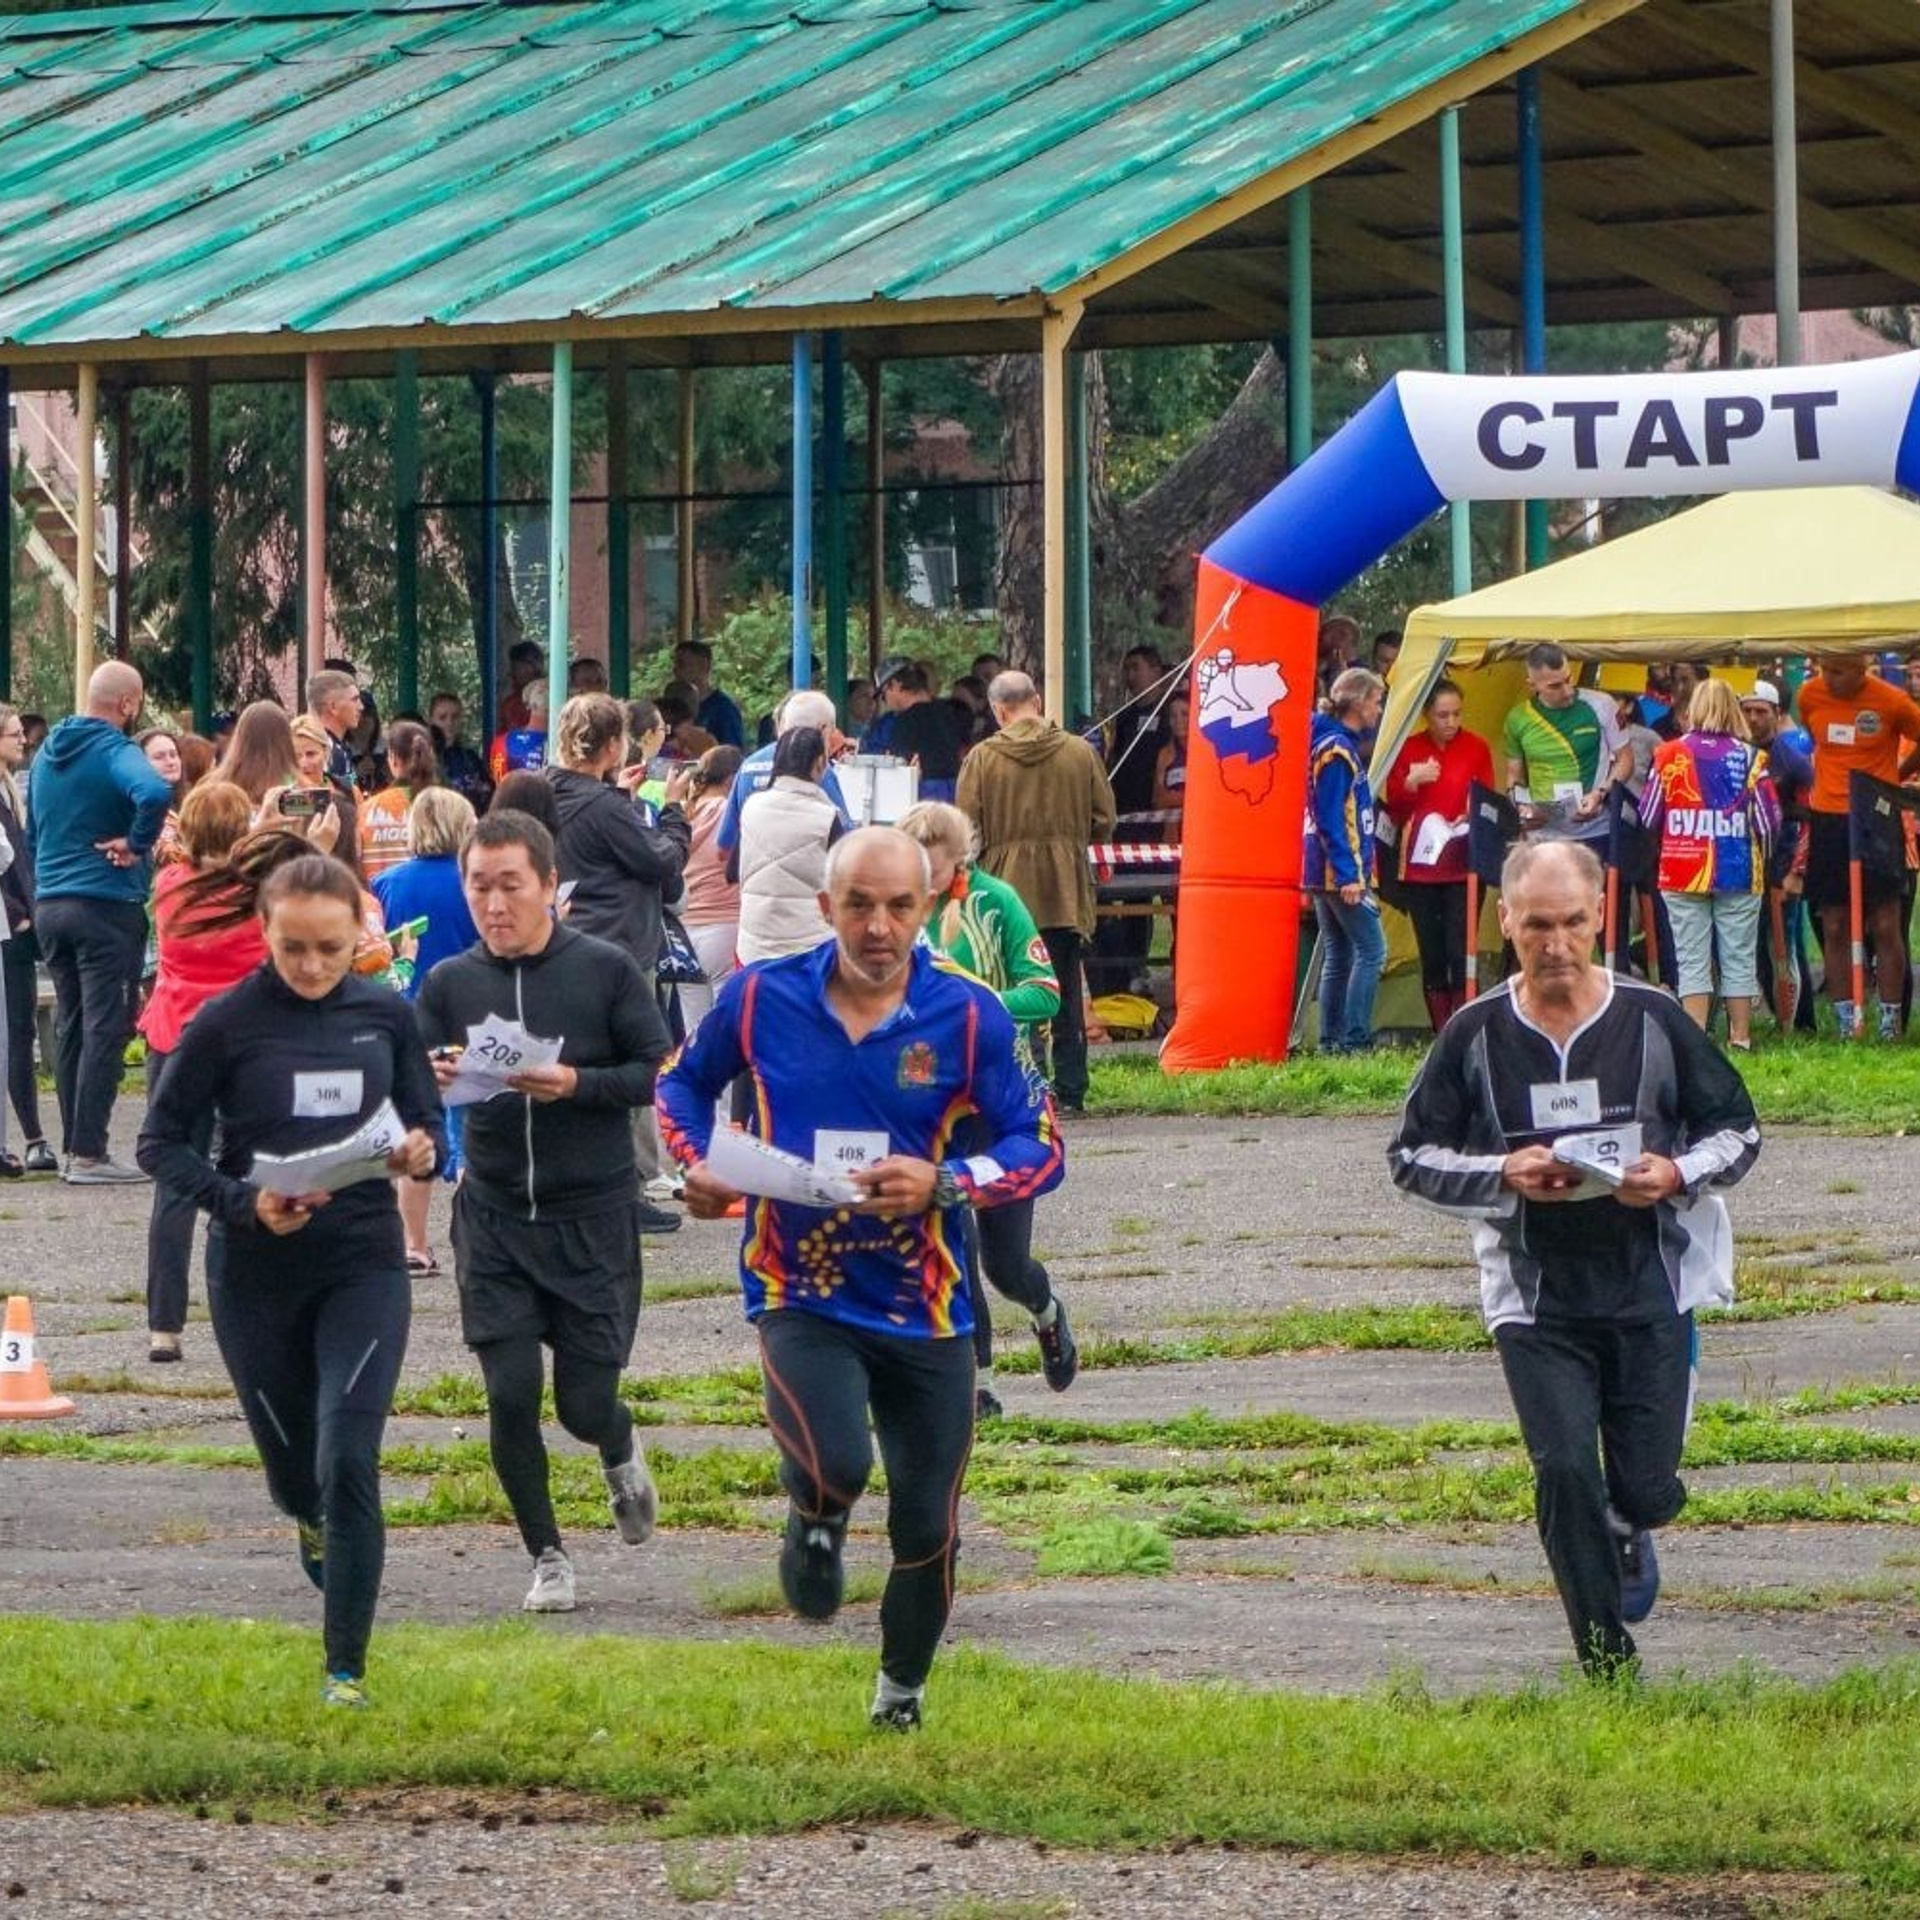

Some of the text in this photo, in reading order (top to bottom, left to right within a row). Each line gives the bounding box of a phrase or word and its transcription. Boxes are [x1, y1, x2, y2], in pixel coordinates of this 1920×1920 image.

[1477, 390, 1838, 471] СТАРТ
[1668, 808, 1747, 840] СУДЬЯ
[479, 1036, 522, 1067] 208
[314, 1088, 341, 1102] 308
[1551, 1096, 1578, 1112] 608
[834, 1146, 865, 1161] 408
[6, 1341, 20, 1362] 3
